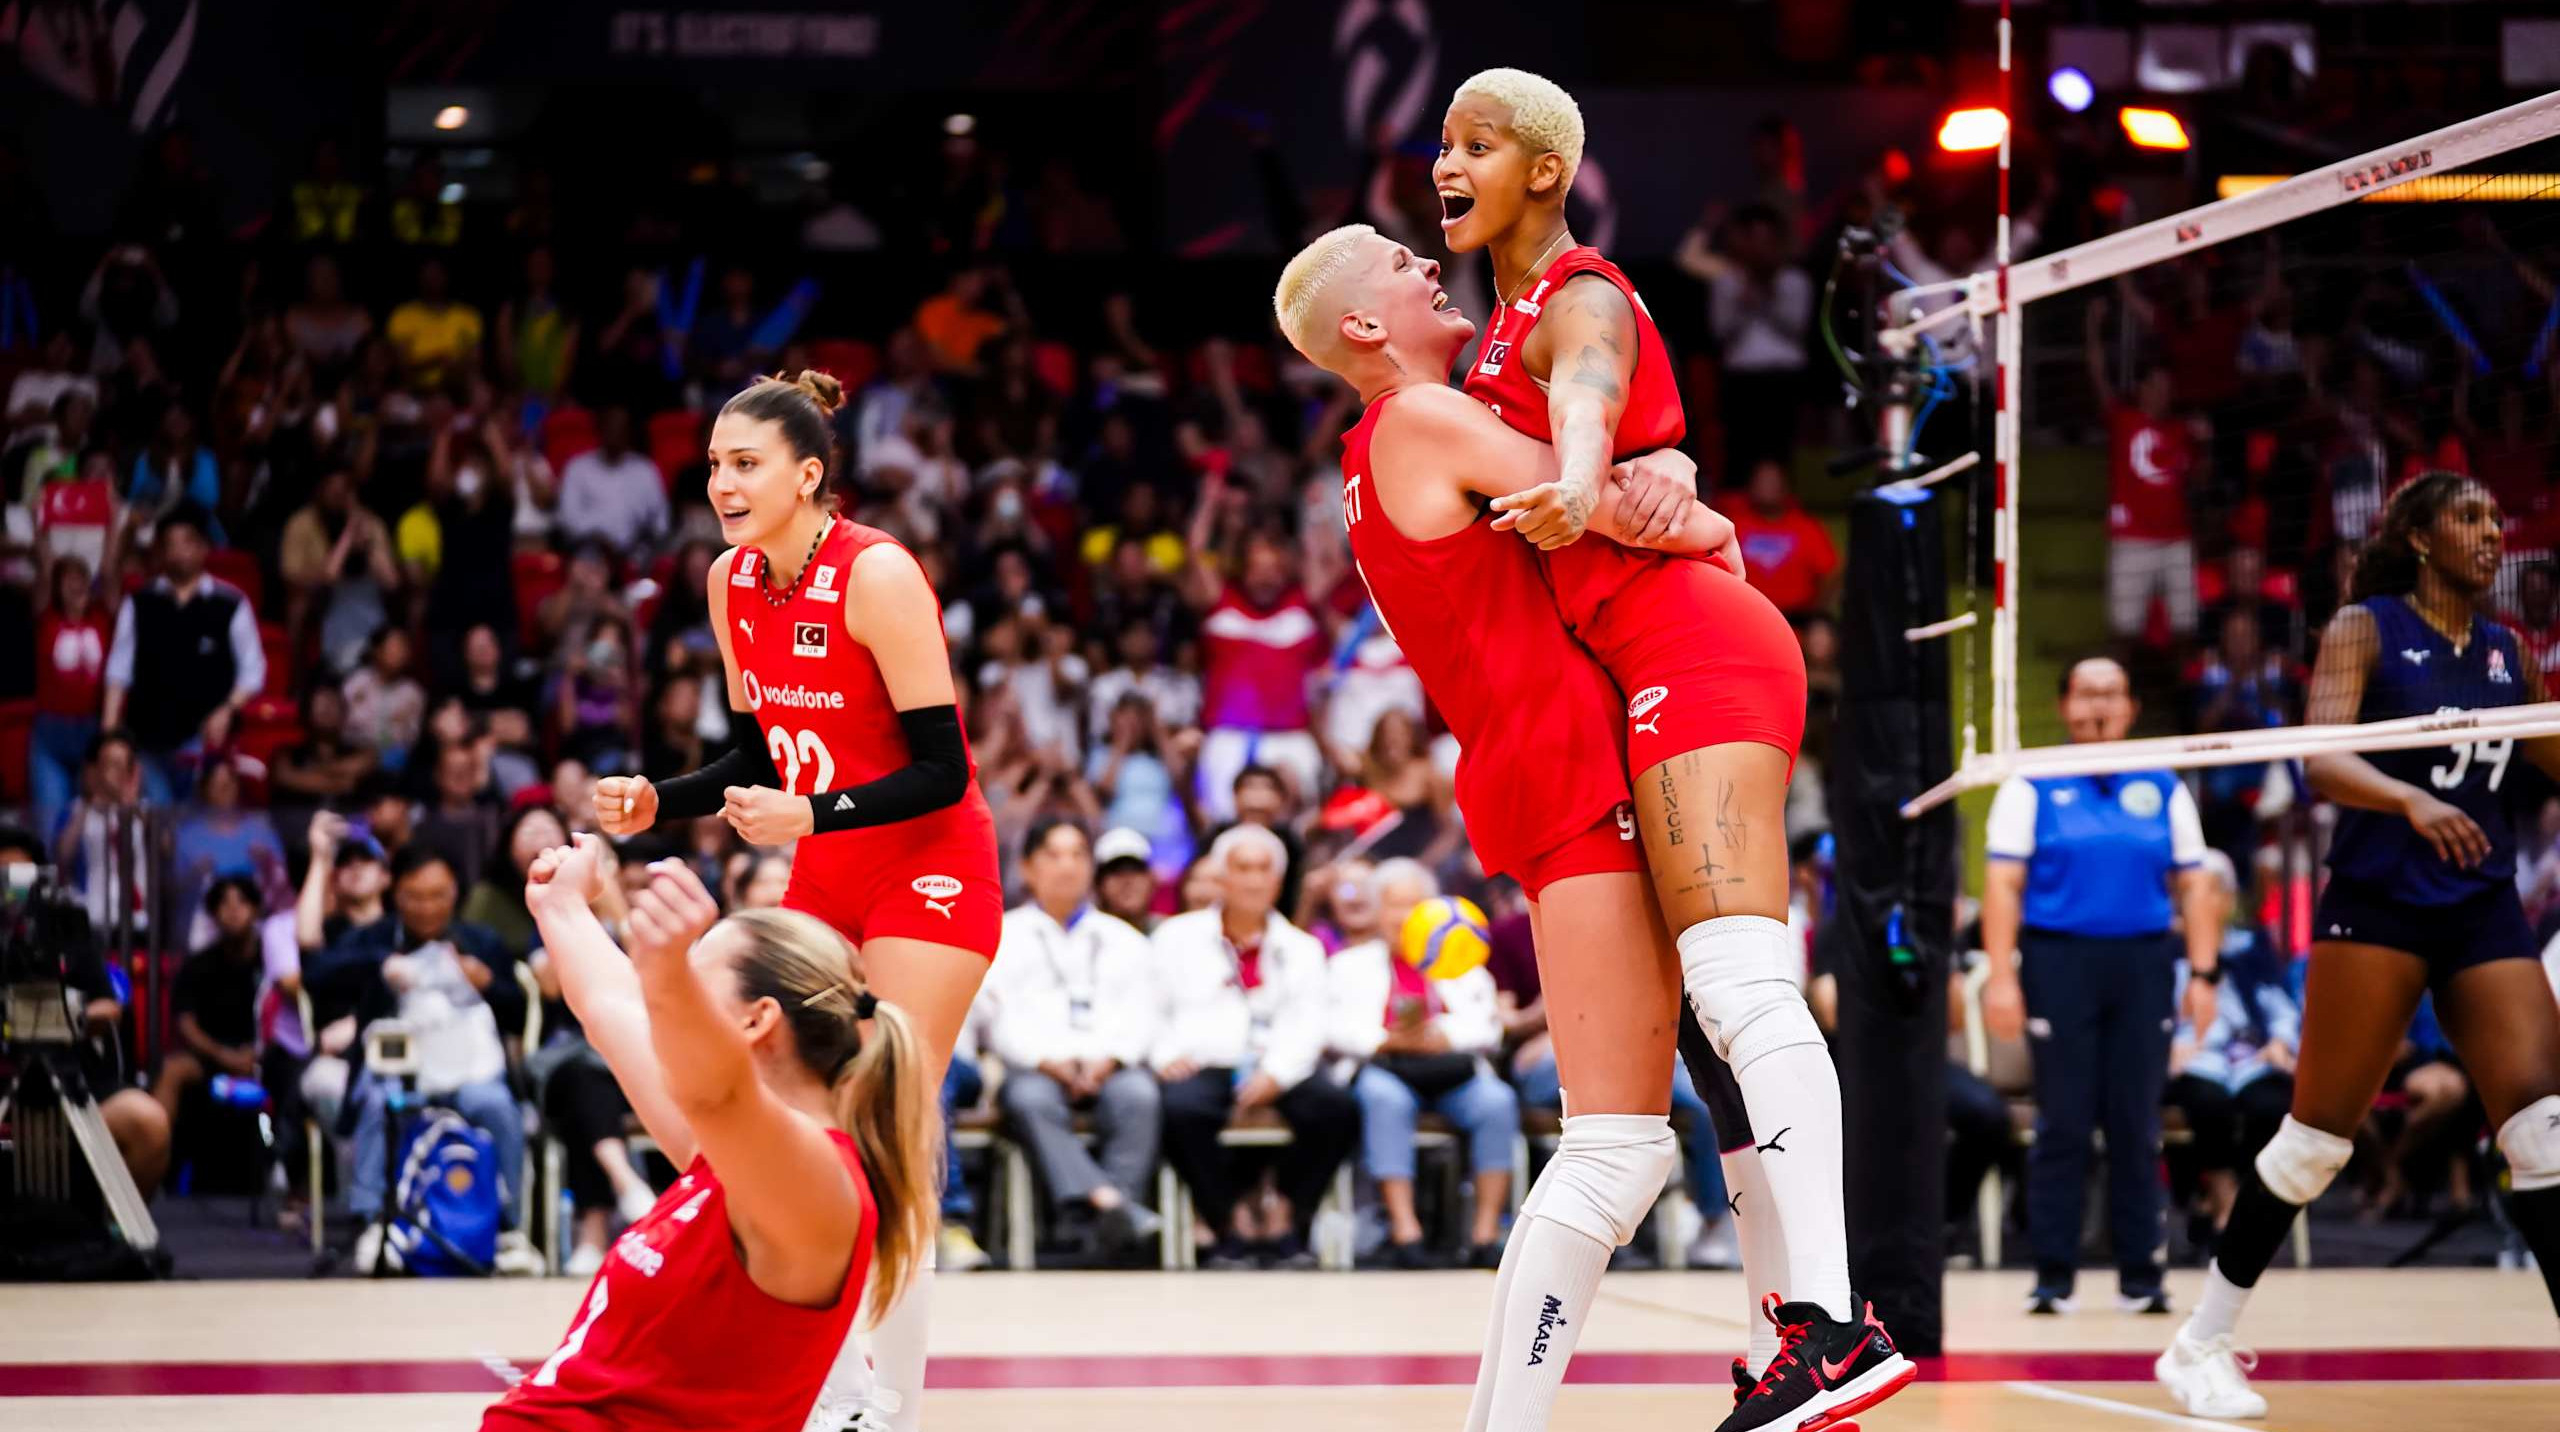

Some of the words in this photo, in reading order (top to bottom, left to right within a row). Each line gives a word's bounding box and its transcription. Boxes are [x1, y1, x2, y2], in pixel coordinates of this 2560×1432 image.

[819, 570, 831, 583] S
[762, 684, 845, 709] vodafone
[1629, 688, 1663, 714] gratis
[917, 877, 958, 891] gratis
[1527, 1294, 1567, 1367] MIKASA
